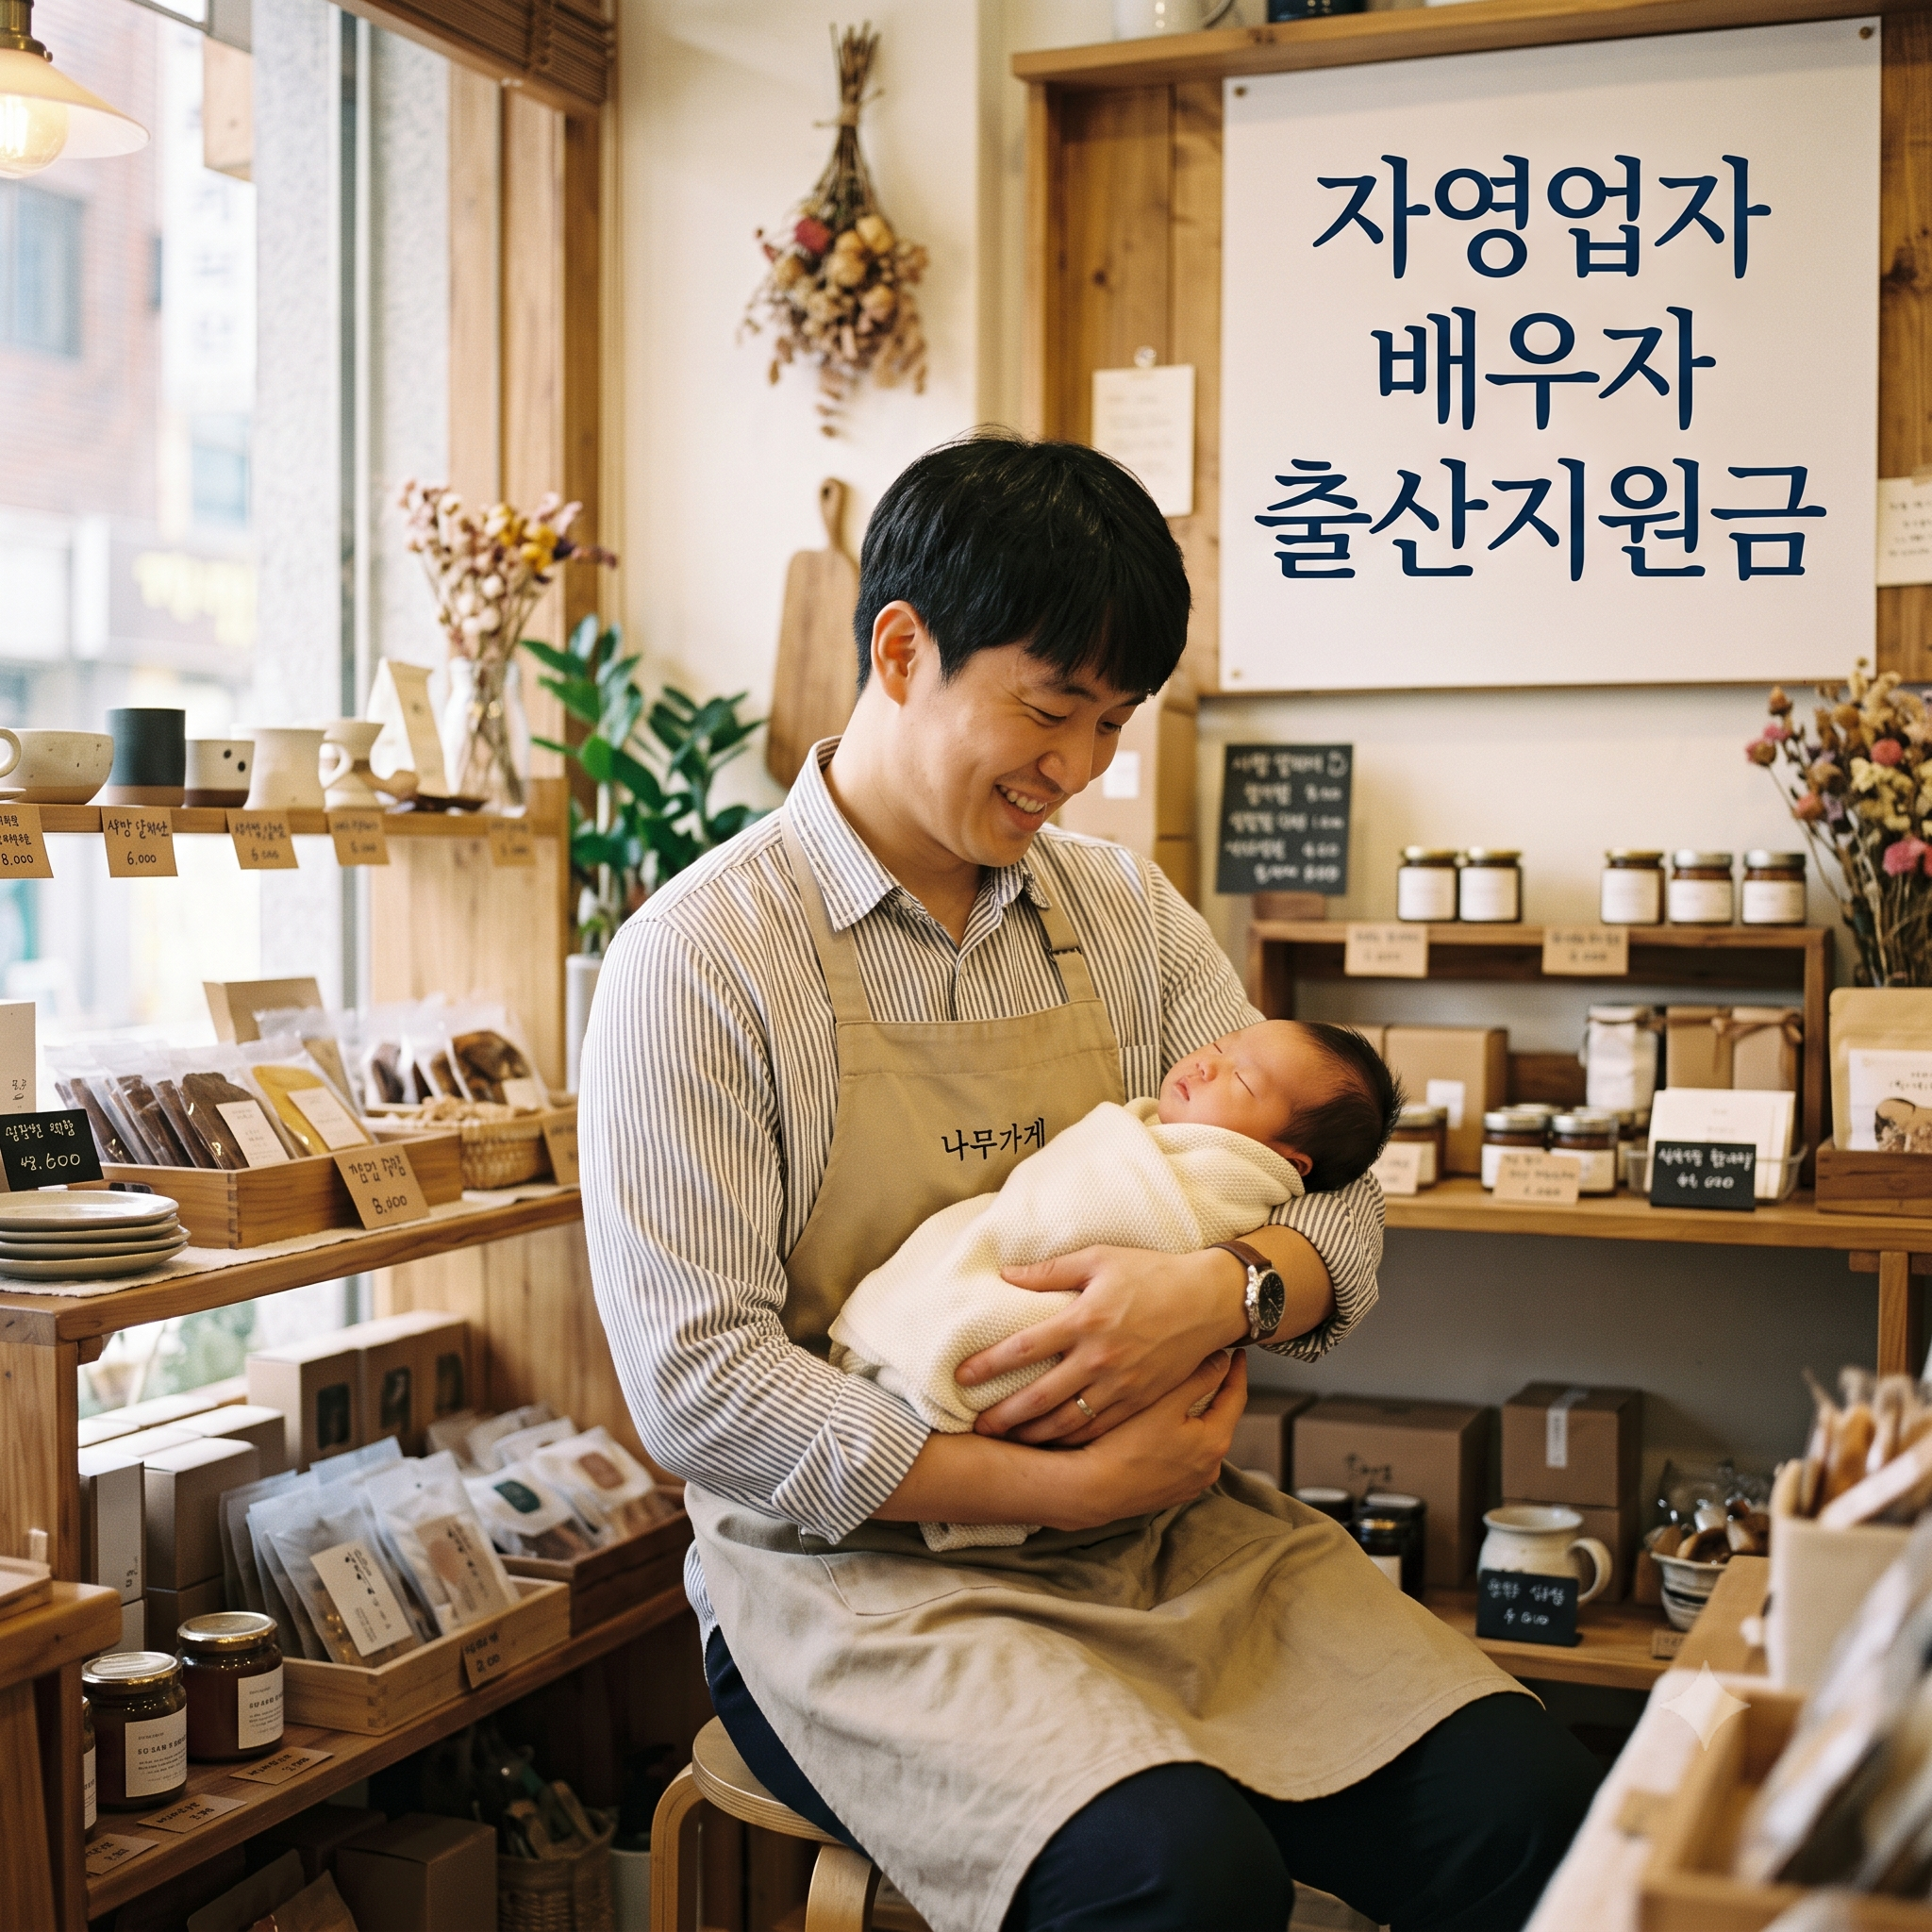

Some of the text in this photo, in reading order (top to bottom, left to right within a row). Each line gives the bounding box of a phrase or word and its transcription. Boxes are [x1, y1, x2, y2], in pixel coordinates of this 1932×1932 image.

[1312, 154, 1772, 279] 자영업자
[1370, 306, 1717, 431] 배우자
[1254, 458, 1827, 582] 출산지원금
[941, 1117, 1045, 1161] 나무가게
